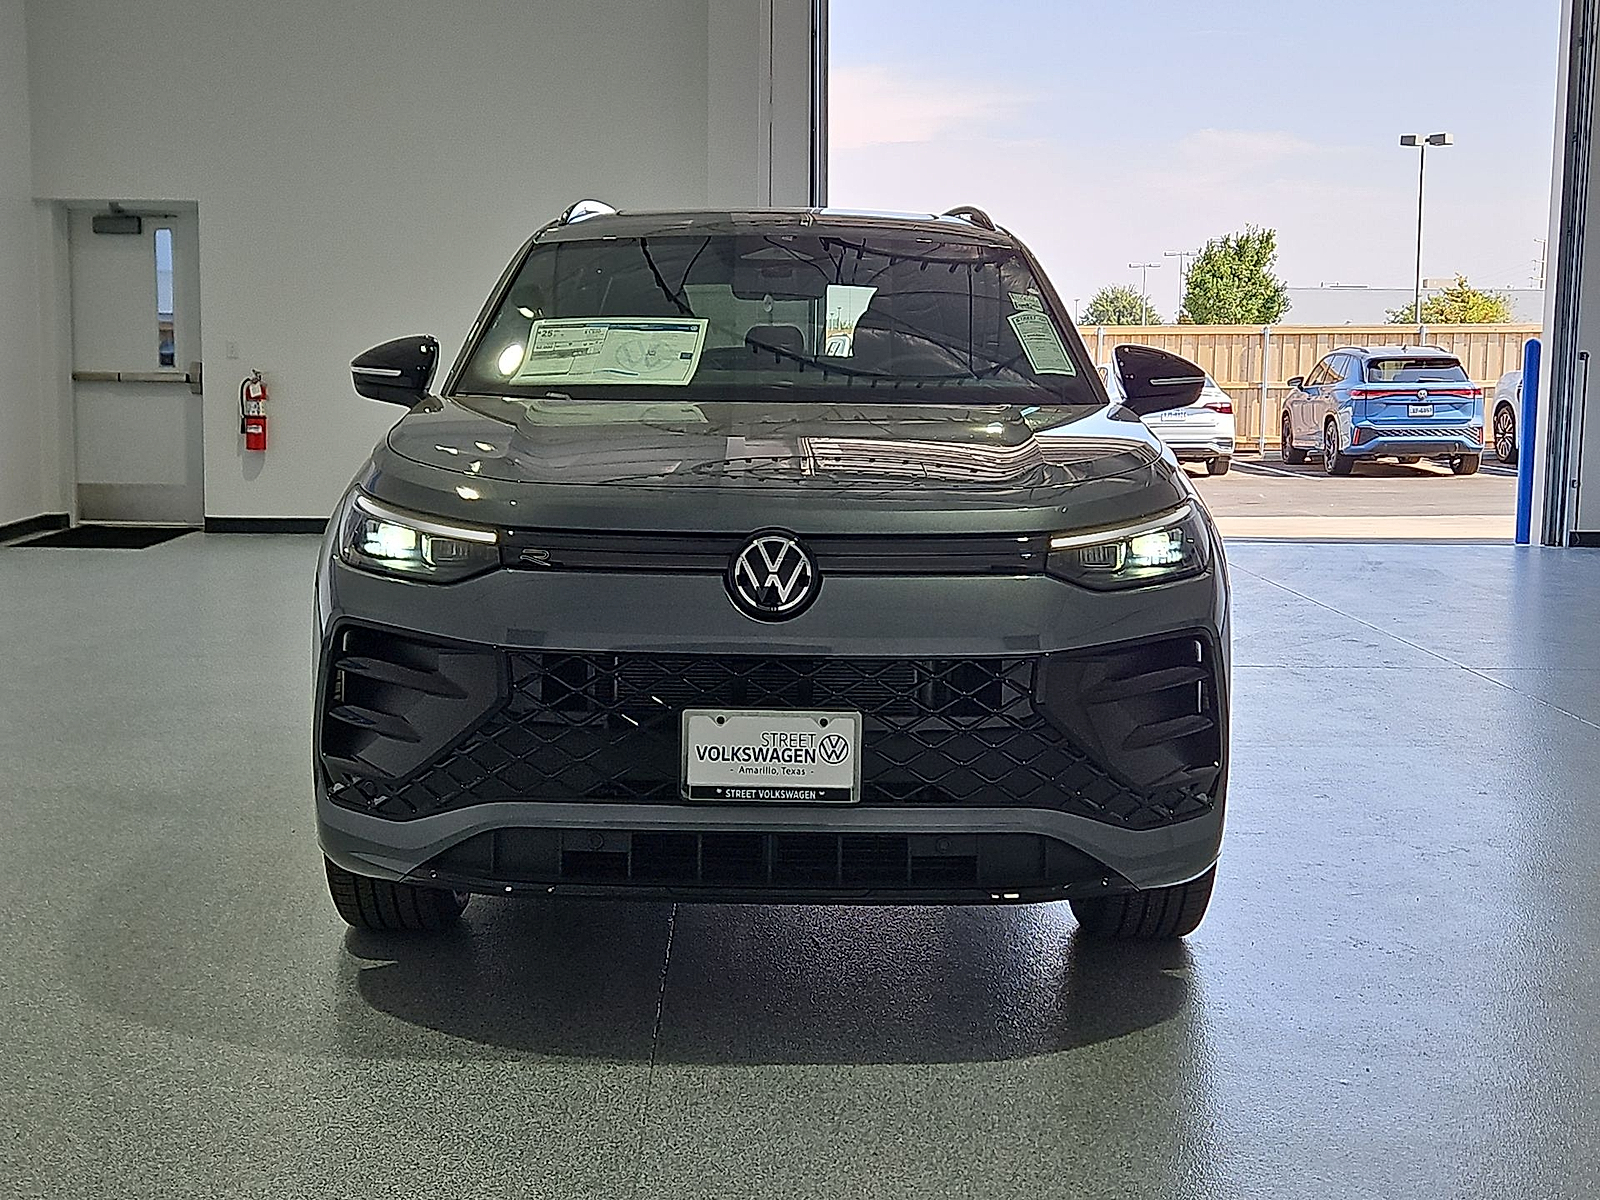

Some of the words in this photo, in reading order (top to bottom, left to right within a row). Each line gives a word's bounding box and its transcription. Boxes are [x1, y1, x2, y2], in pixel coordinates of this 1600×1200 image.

[761, 731, 817, 748] STREET
[696, 745, 817, 764] VOLKSWAGEN
[738, 765, 779, 776] Amarillo,
[781, 766, 806, 776] Texas
[725, 789, 757, 799] STREET
[757, 789, 817, 800] VOLKSWAGEN
